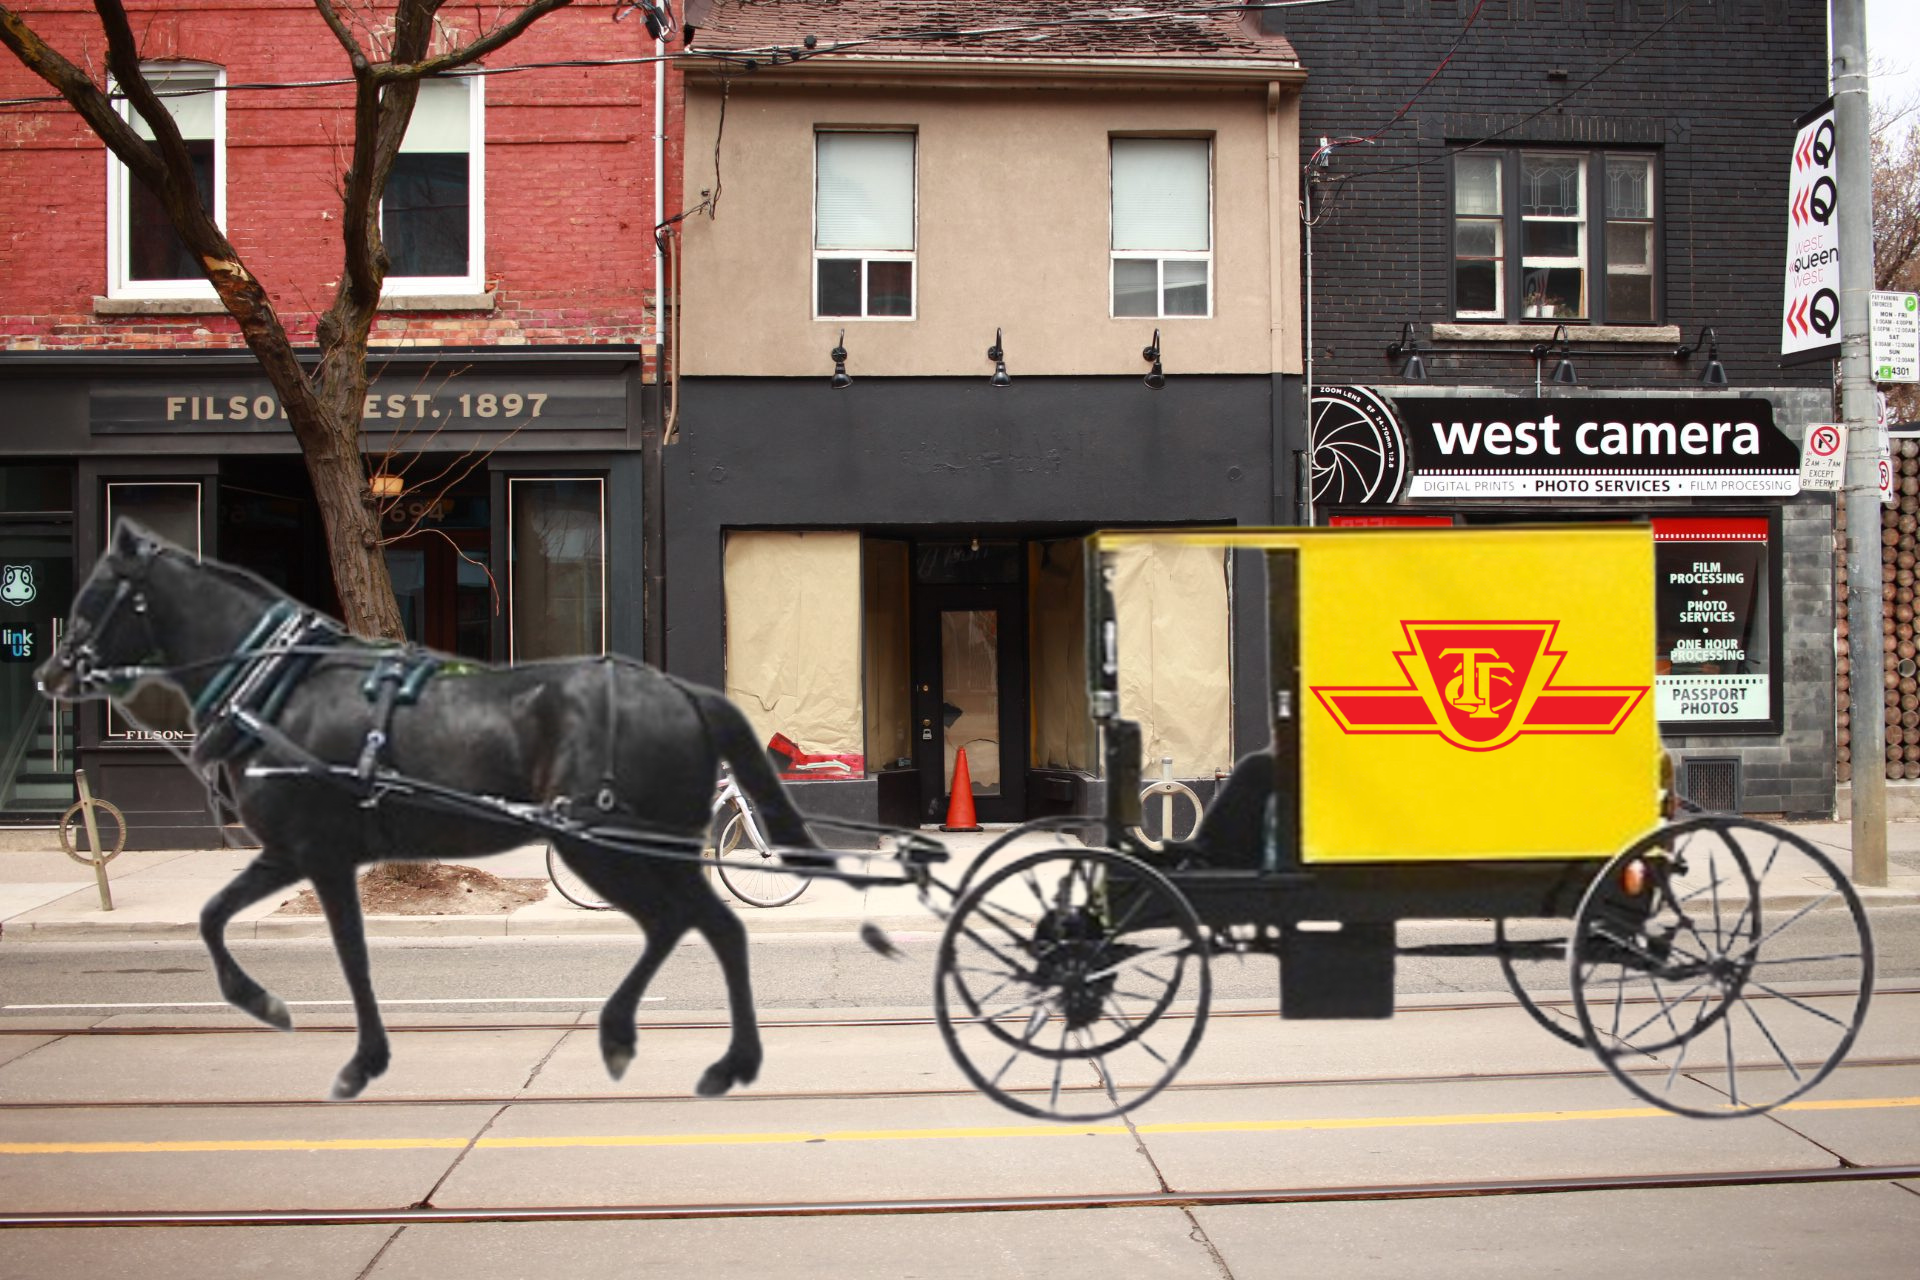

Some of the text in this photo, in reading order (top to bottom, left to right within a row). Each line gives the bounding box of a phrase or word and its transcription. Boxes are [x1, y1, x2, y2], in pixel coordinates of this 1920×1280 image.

[1812, 118, 1836, 170] Q
[1810, 175, 1837, 226] Q
[1794, 234, 1824, 255] west
[1793, 268, 1824, 289] west
[1810, 287, 1840, 338] Q
[1891, 367, 1910, 376] 4301
[1320, 386, 1362, 404] ZOOM LENS
[363, 394, 440, 420] EST.
[459, 393, 549, 419] 1897
[1366, 404, 1376, 413] EF
[1432, 414, 1761, 456] west camera
[1808, 469, 1835, 478] EXCEPT
[1424, 479, 1792, 493] DIGITAL PRINTS PHOTO SERVICES FILM PROCESSING
[1802, 479, 1811, 487] BY
[389, 502, 445, 523] 694
[1692, 562, 1721, 573] FILM
[1670, 573, 1745, 584] PROCESSING
[1687, 600, 1728, 611] PHOTO
[1679, 611, 1736, 623] SERVICES
[3, 629, 34, 645] link
[1676, 639, 1738, 650] ONE HOUR
[1670, 650, 1745, 661] PROCESSING
[1672, 687, 1748, 701] PASSPORT
[1681, 701, 1739, 715] PHOTOS
[126, 730, 184, 740] FILSON
